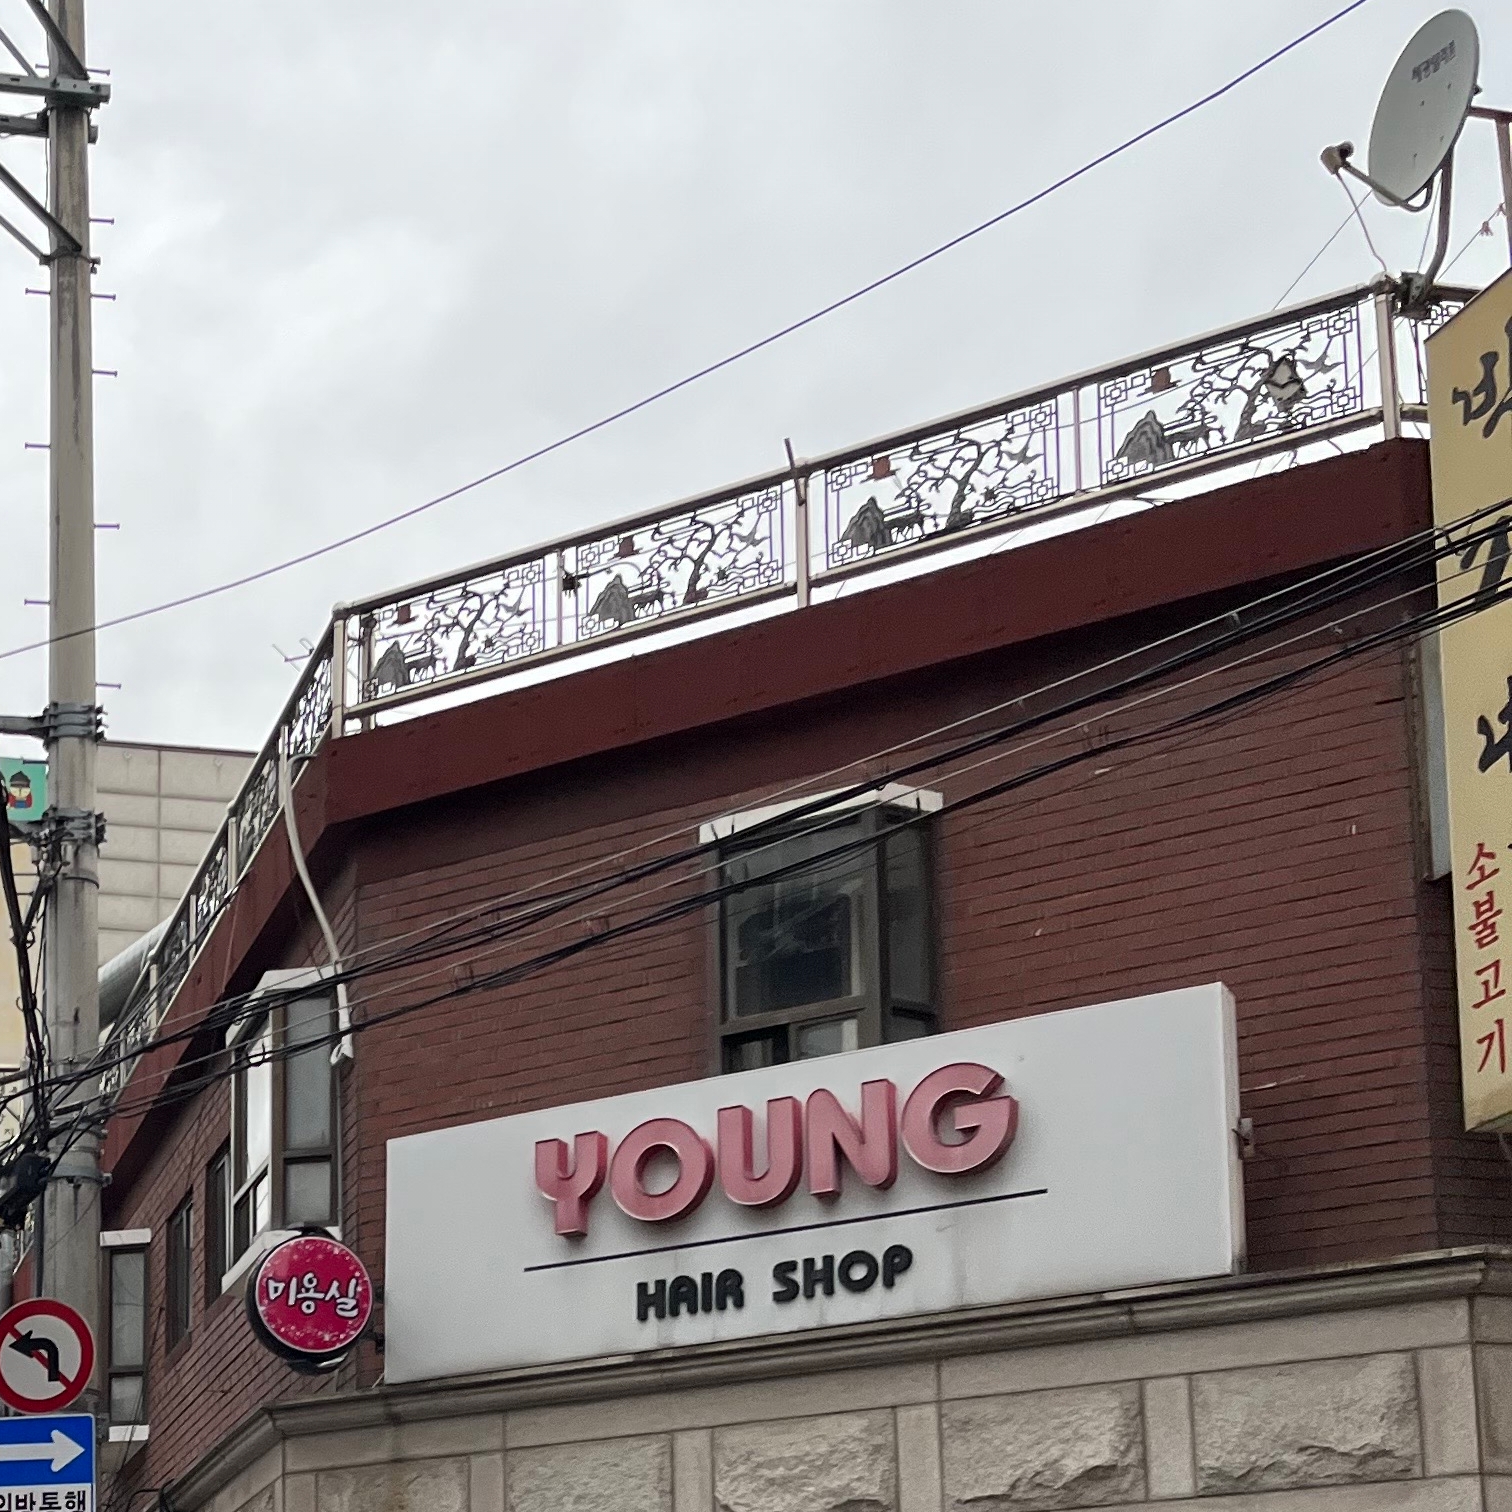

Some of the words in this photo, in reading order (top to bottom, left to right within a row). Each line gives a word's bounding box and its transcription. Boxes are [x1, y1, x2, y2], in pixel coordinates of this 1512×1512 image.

[1465, 842, 1506, 1074] 소불고기
[534, 1061, 1018, 1238] YOUNG
[267, 1271, 359, 1318] 미용실
[636, 1268, 745, 1323] HAIR
[772, 1244, 913, 1303] SHOP
